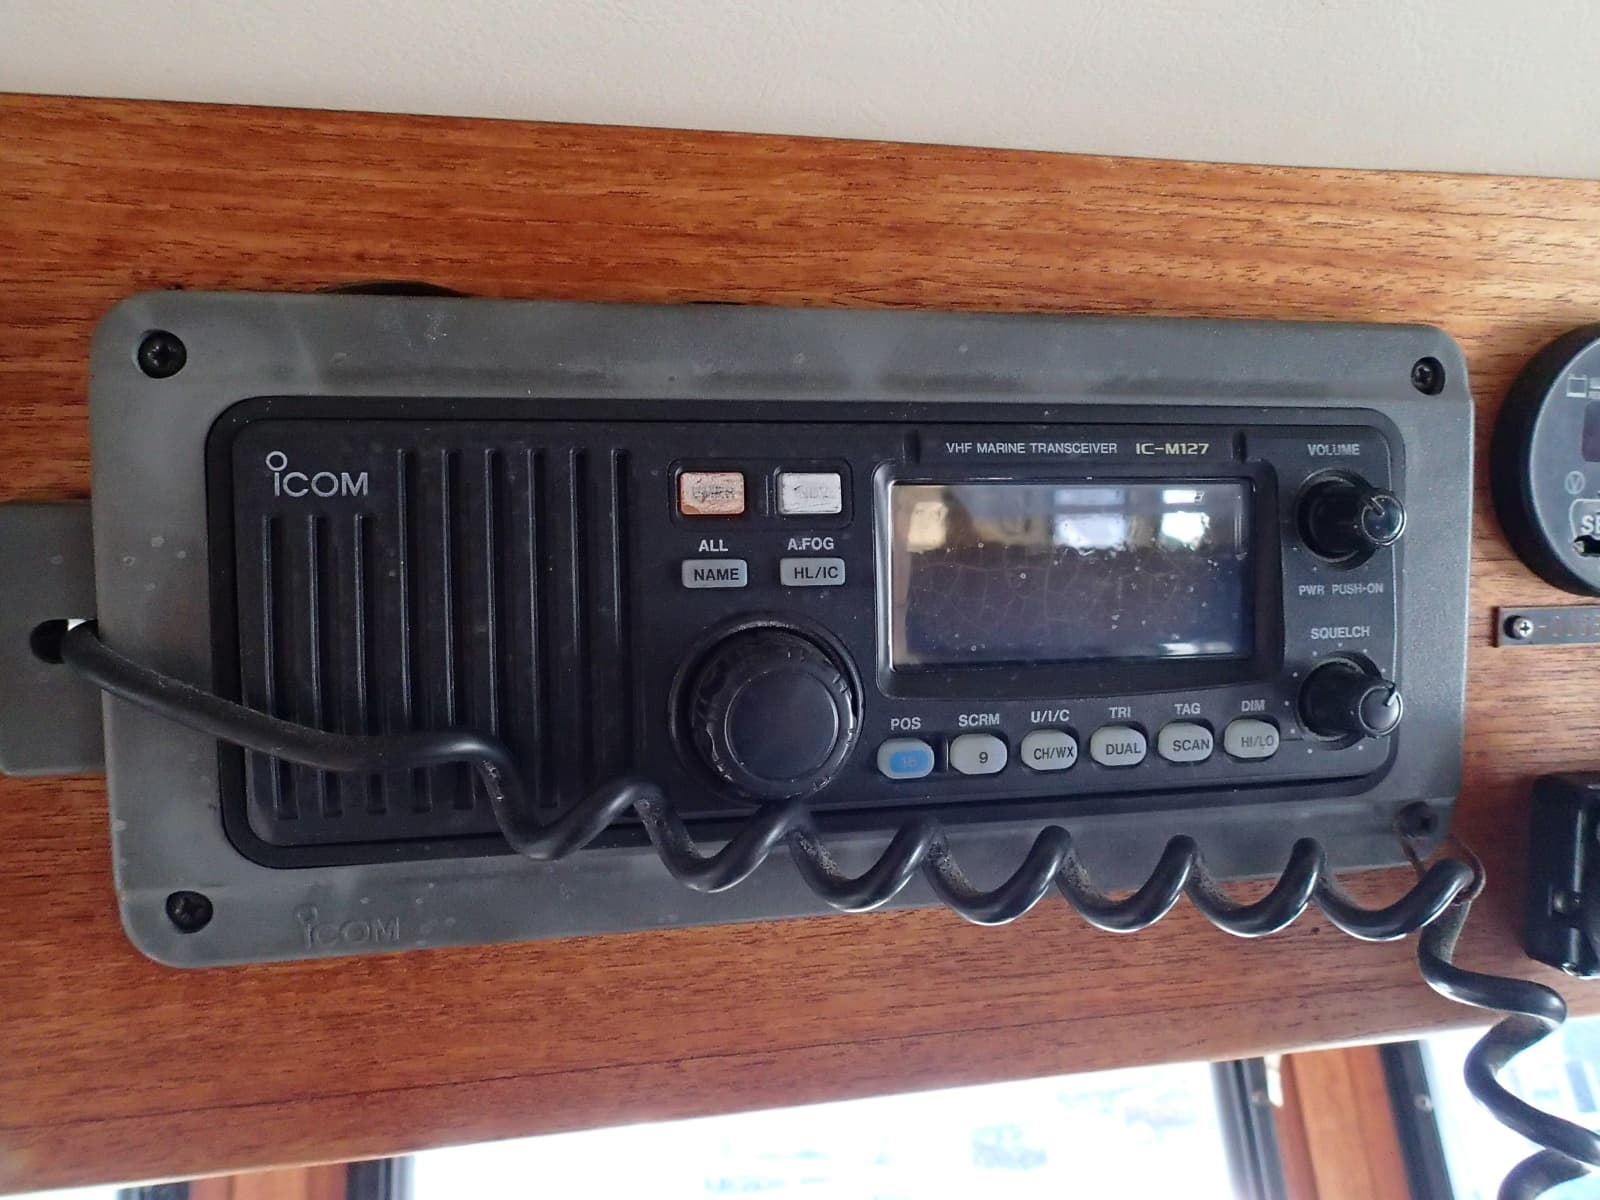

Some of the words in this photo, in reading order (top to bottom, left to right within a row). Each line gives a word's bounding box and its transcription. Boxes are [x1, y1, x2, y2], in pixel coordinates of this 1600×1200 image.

[946, 442, 973, 454] VHF
[977, 442, 1026, 454] MARINE
[1030, 442, 1118, 455] TRANSCEIVER
[1135, 442, 1210, 456] IC-M127
[1307, 443, 1361, 456] VOLUME
[698, 539, 729, 552] ALL
[787, 537, 835, 550] A.FOG
[693, 567, 740, 582] NAME
[793, 565, 839, 579] HL/IC
[1298, 583, 1326, 596] PWR
[1331, 582, 1384, 595] PUSH-ON
[1310, 625, 1371, 639] SQUELCH
[1109, 705, 1132, 719] TRI
[1173, 702, 1201, 716] TAG
[1240, 699, 1266, 713] DIM
[890, 716, 922, 731] POS
[958, 712, 1000, 727] SCRM
[1171, 737, 1211, 753] SCAN
[1240, 733, 1275, 749] HI/LO
[1033, 745, 1075, 761] CH/WX
[1105, 741, 1142, 756] DUAL
[979, 751, 989, 764] 9
